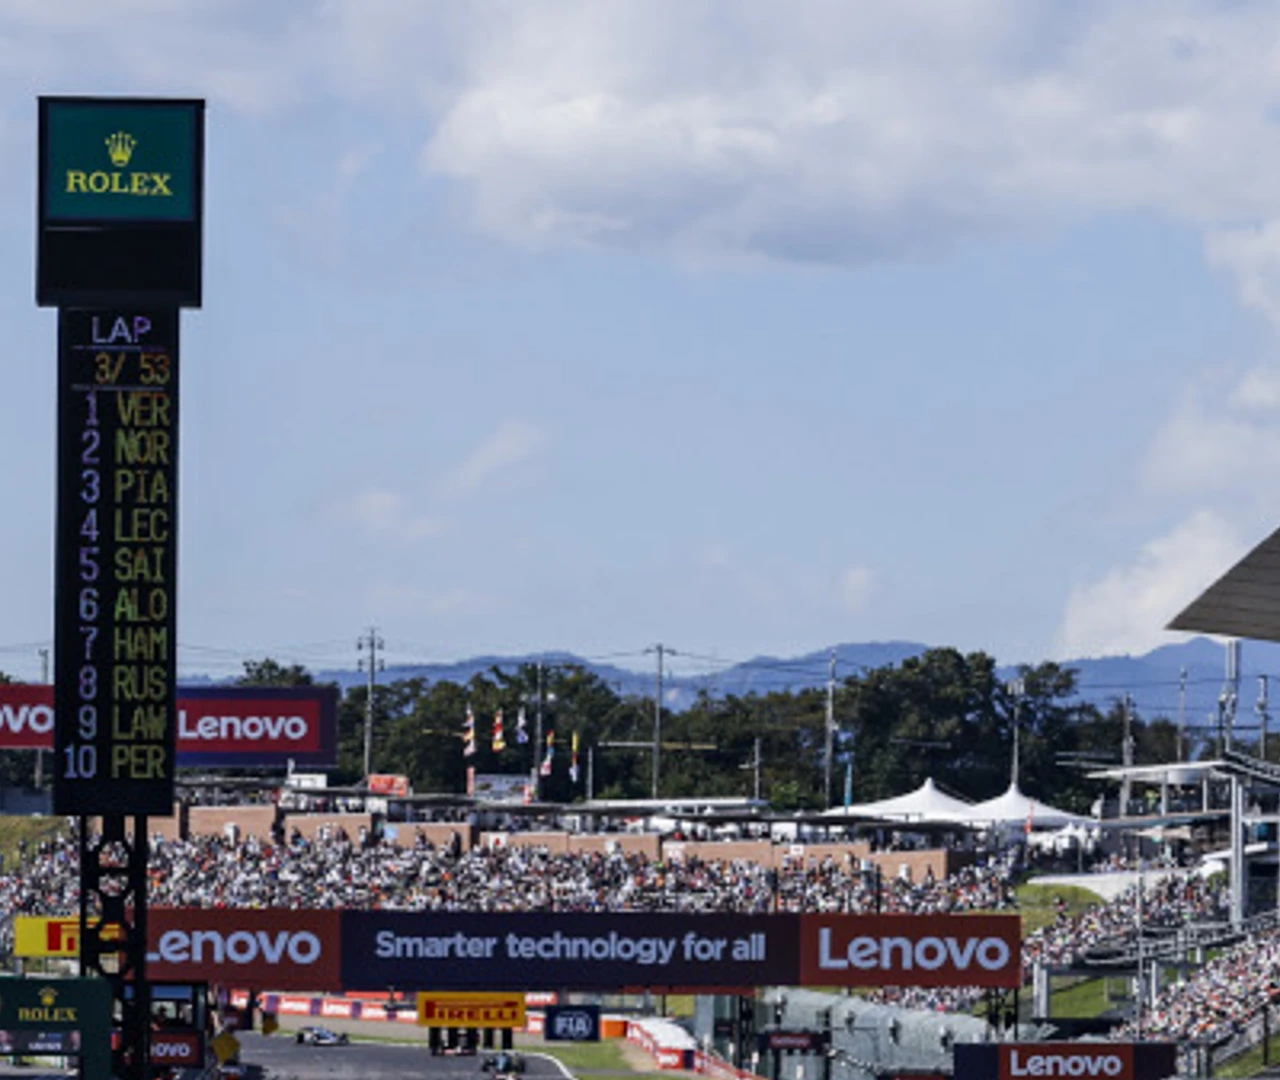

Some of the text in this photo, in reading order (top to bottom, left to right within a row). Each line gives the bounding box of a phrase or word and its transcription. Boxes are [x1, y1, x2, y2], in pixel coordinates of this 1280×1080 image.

[66, 171, 173, 196] ROLEX
[91, 316, 151, 344] LAP
[139, 354, 171, 384] 53
[85, 391, 170, 427] 1 VER
[81, 429, 169, 465] 2 NOR
[80, 469, 169, 503] 3 PIA
[79, 508, 168, 542] 4 LEC
[79, 547, 165, 582] 5 SAI
[78, 587, 167, 622] 6 ALO
[79, 626, 167, 661] 7 HAM
[78, 665, 167, 701] 8 RUS
[78, 704, 167, 740] 9 LAW
[178, 711, 308, 740] Lenovo
[63, 744, 166, 779] 10 PER
[375, 930, 766, 965] Smarter technology for all
[819, 928, 1011, 971] Lenovo
[18, 1007, 78, 1022] ROLEX
[425, 1001, 519, 1021] PIRELLI
[555, 1017, 589, 1032] FIA
[1009, 1050, 1123, 1077] Lenovo
